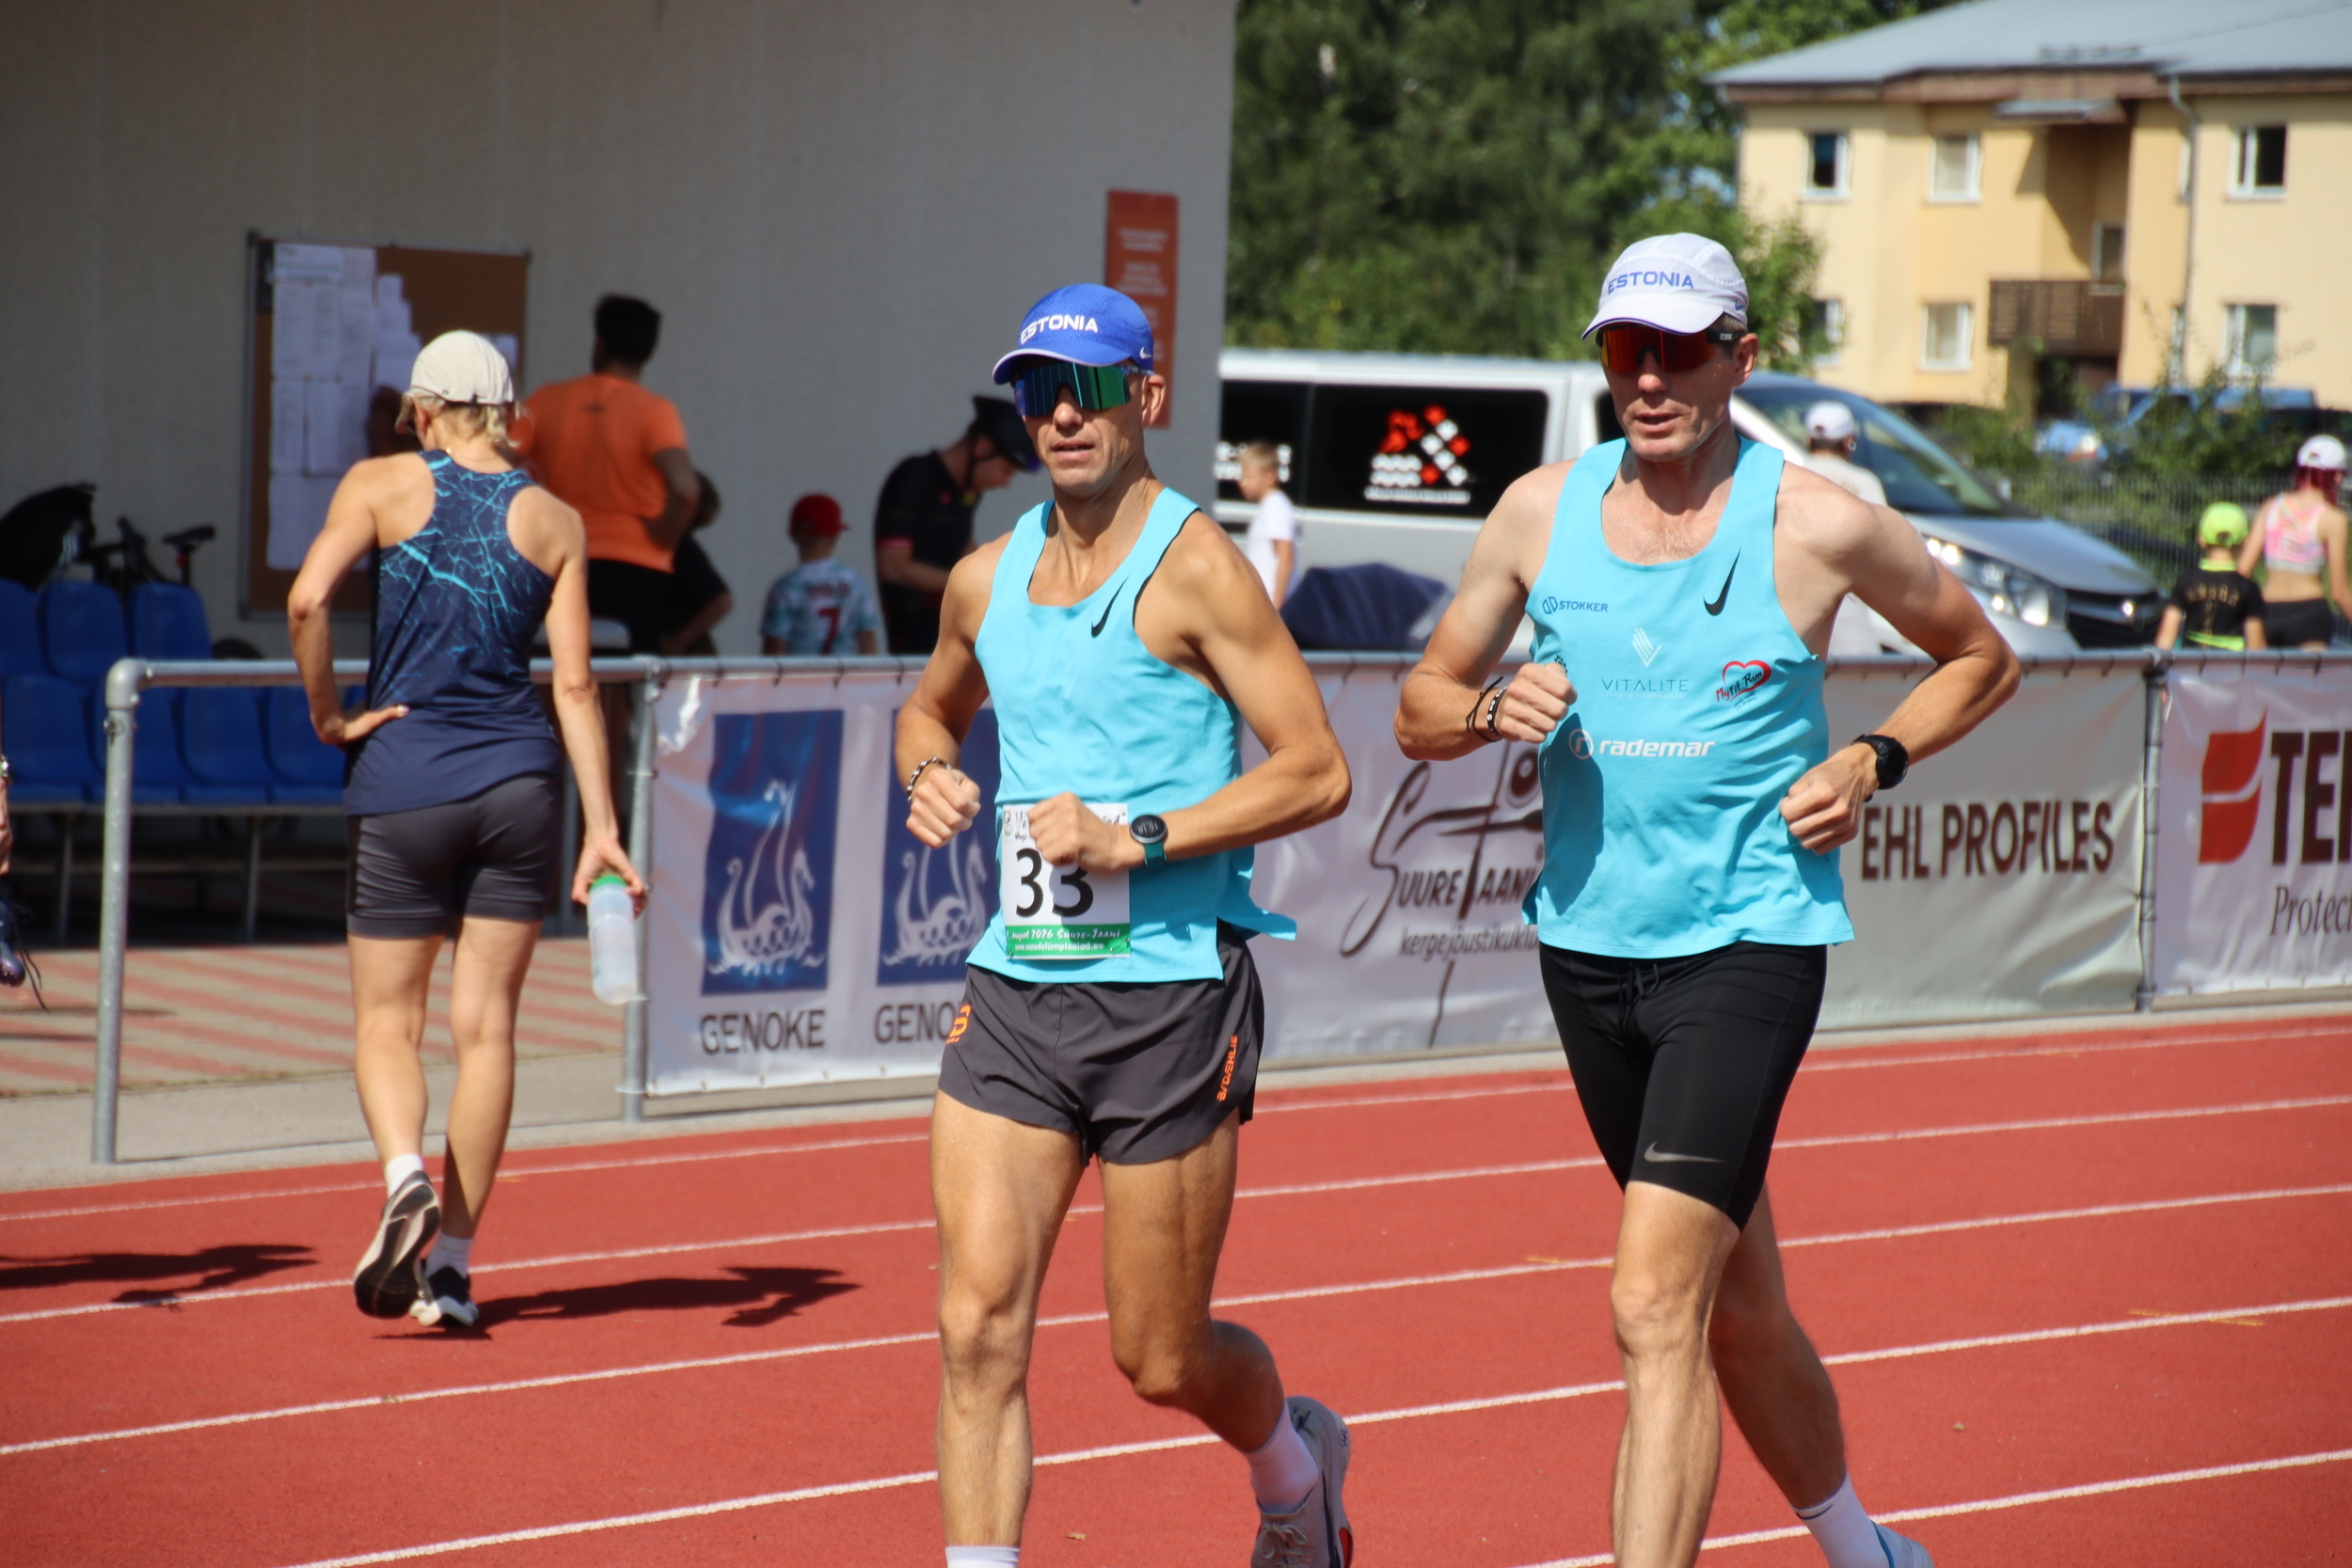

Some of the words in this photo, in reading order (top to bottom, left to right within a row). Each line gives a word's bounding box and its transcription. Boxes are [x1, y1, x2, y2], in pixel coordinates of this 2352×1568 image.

[1608, 271, 1694, 294] ESTONIA
[1020, 313, 1099, 345] ESTONIA
[1559, 600, 1609, 612] STOKKER
[1601, 678, 1690, 692] VITALITE
[1599, 738, 1716, 757] rademar
[1861, 804, 1930, 880] EHL
[1940, 800, 2115, 878] PROFILES
[1016, 847, 1094, 918] 33
[699, 1008, 825, 1055] GENOKE
[874, 1001, 961, 1044] GENO
